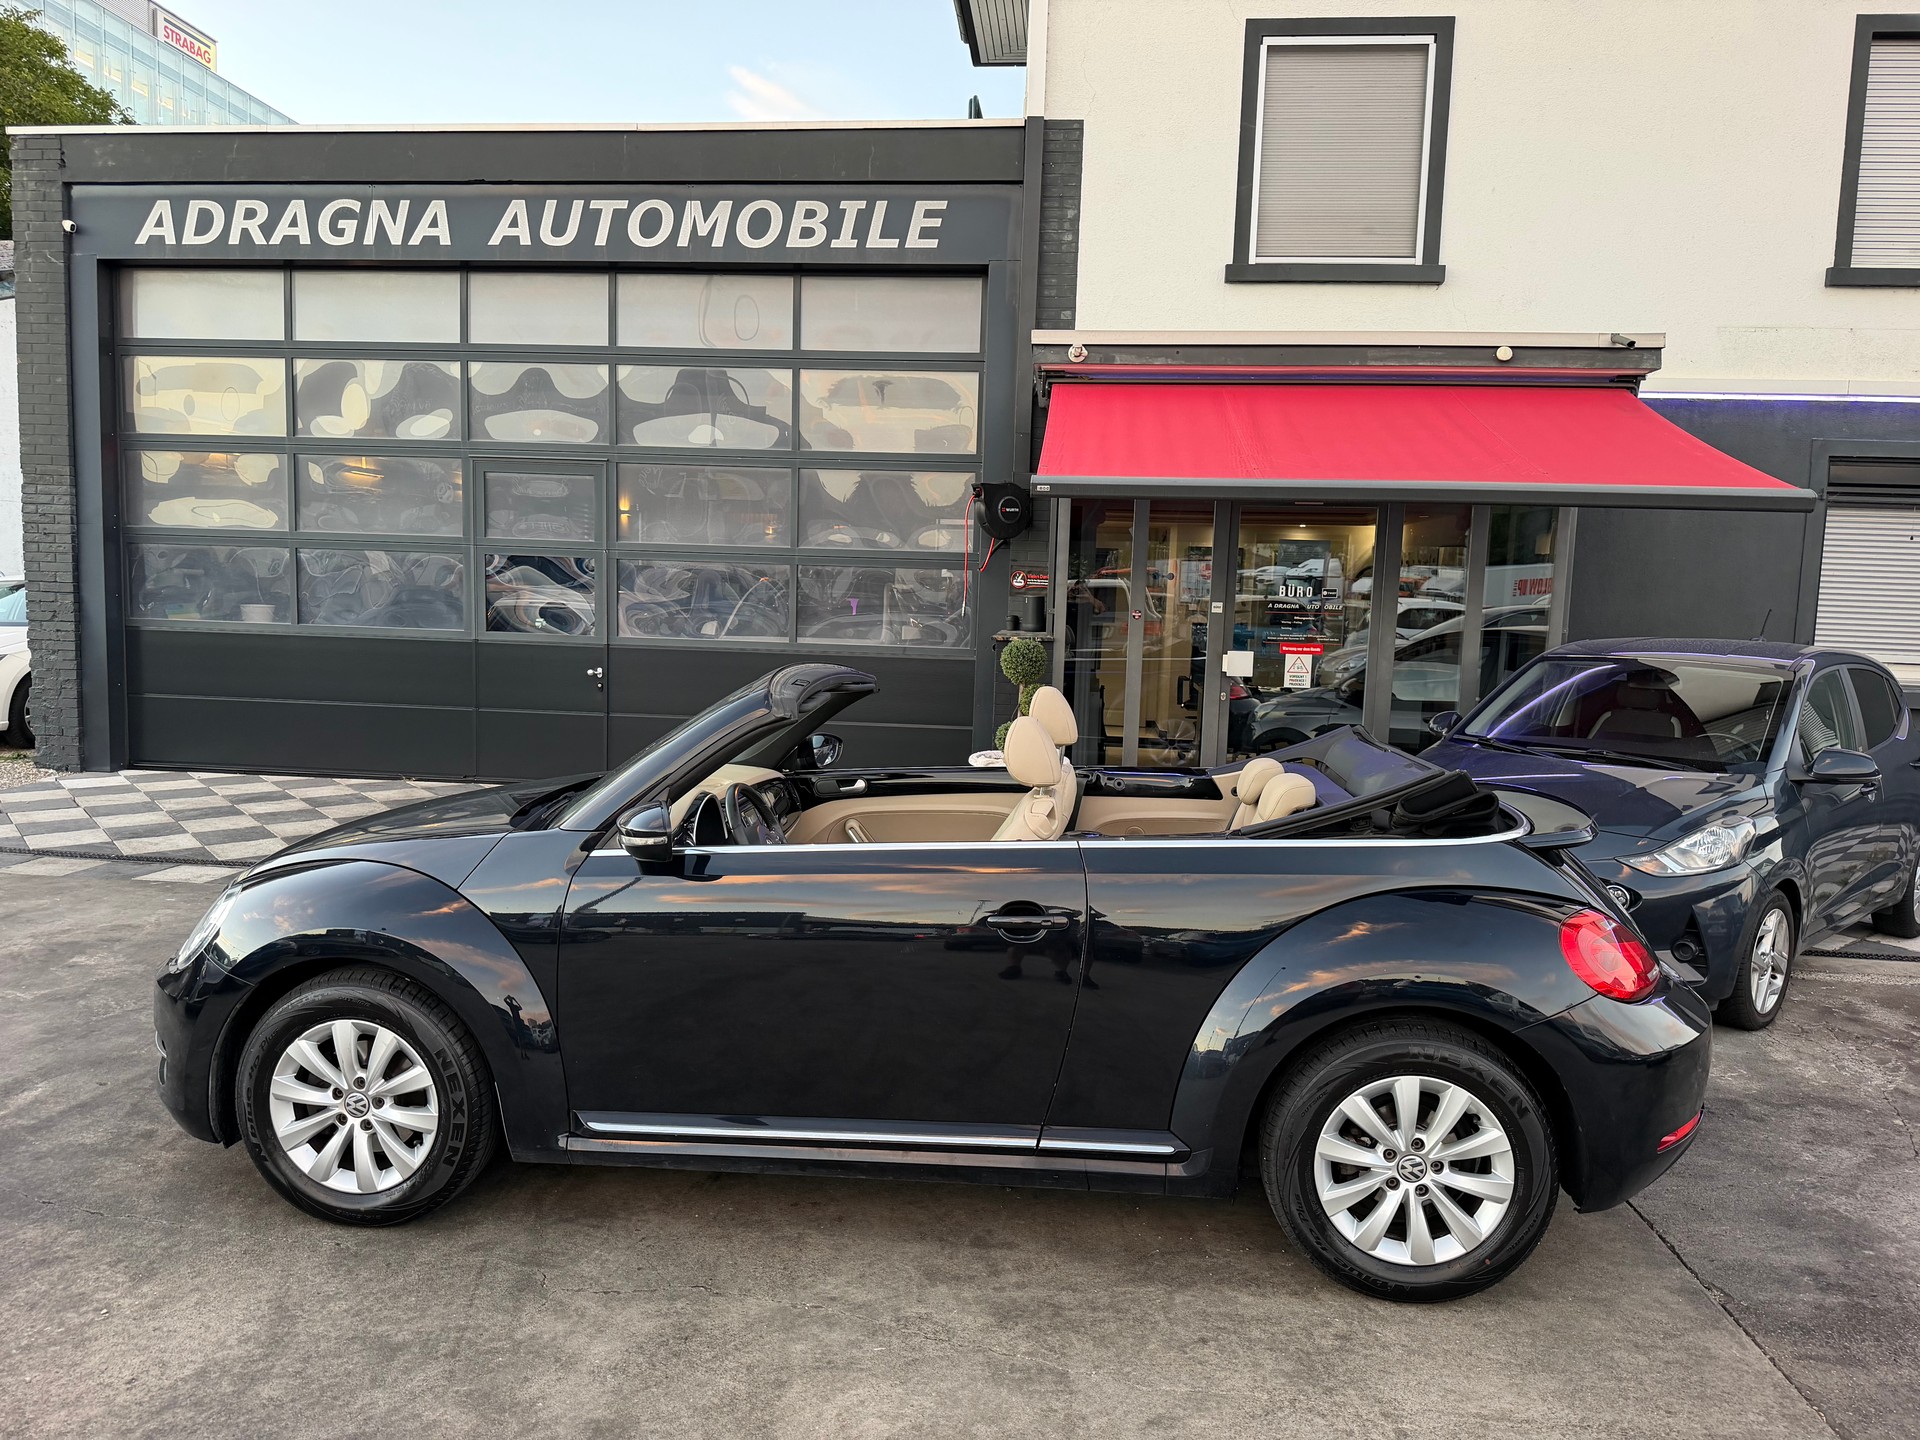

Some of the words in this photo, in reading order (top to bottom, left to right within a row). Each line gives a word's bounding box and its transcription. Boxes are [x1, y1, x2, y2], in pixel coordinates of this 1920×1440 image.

[163, 25, 212, 64] STRABAG
[134, 199, 452, 246] ADRAGNA
[487, 199, 949, 248] AUTOMOBILE
[1279, 584, 1313, 598] BÜRO
[1406, 1046, 1531, 1119] NEXEN
[434, 1048, 466, 1168] NEXEN
